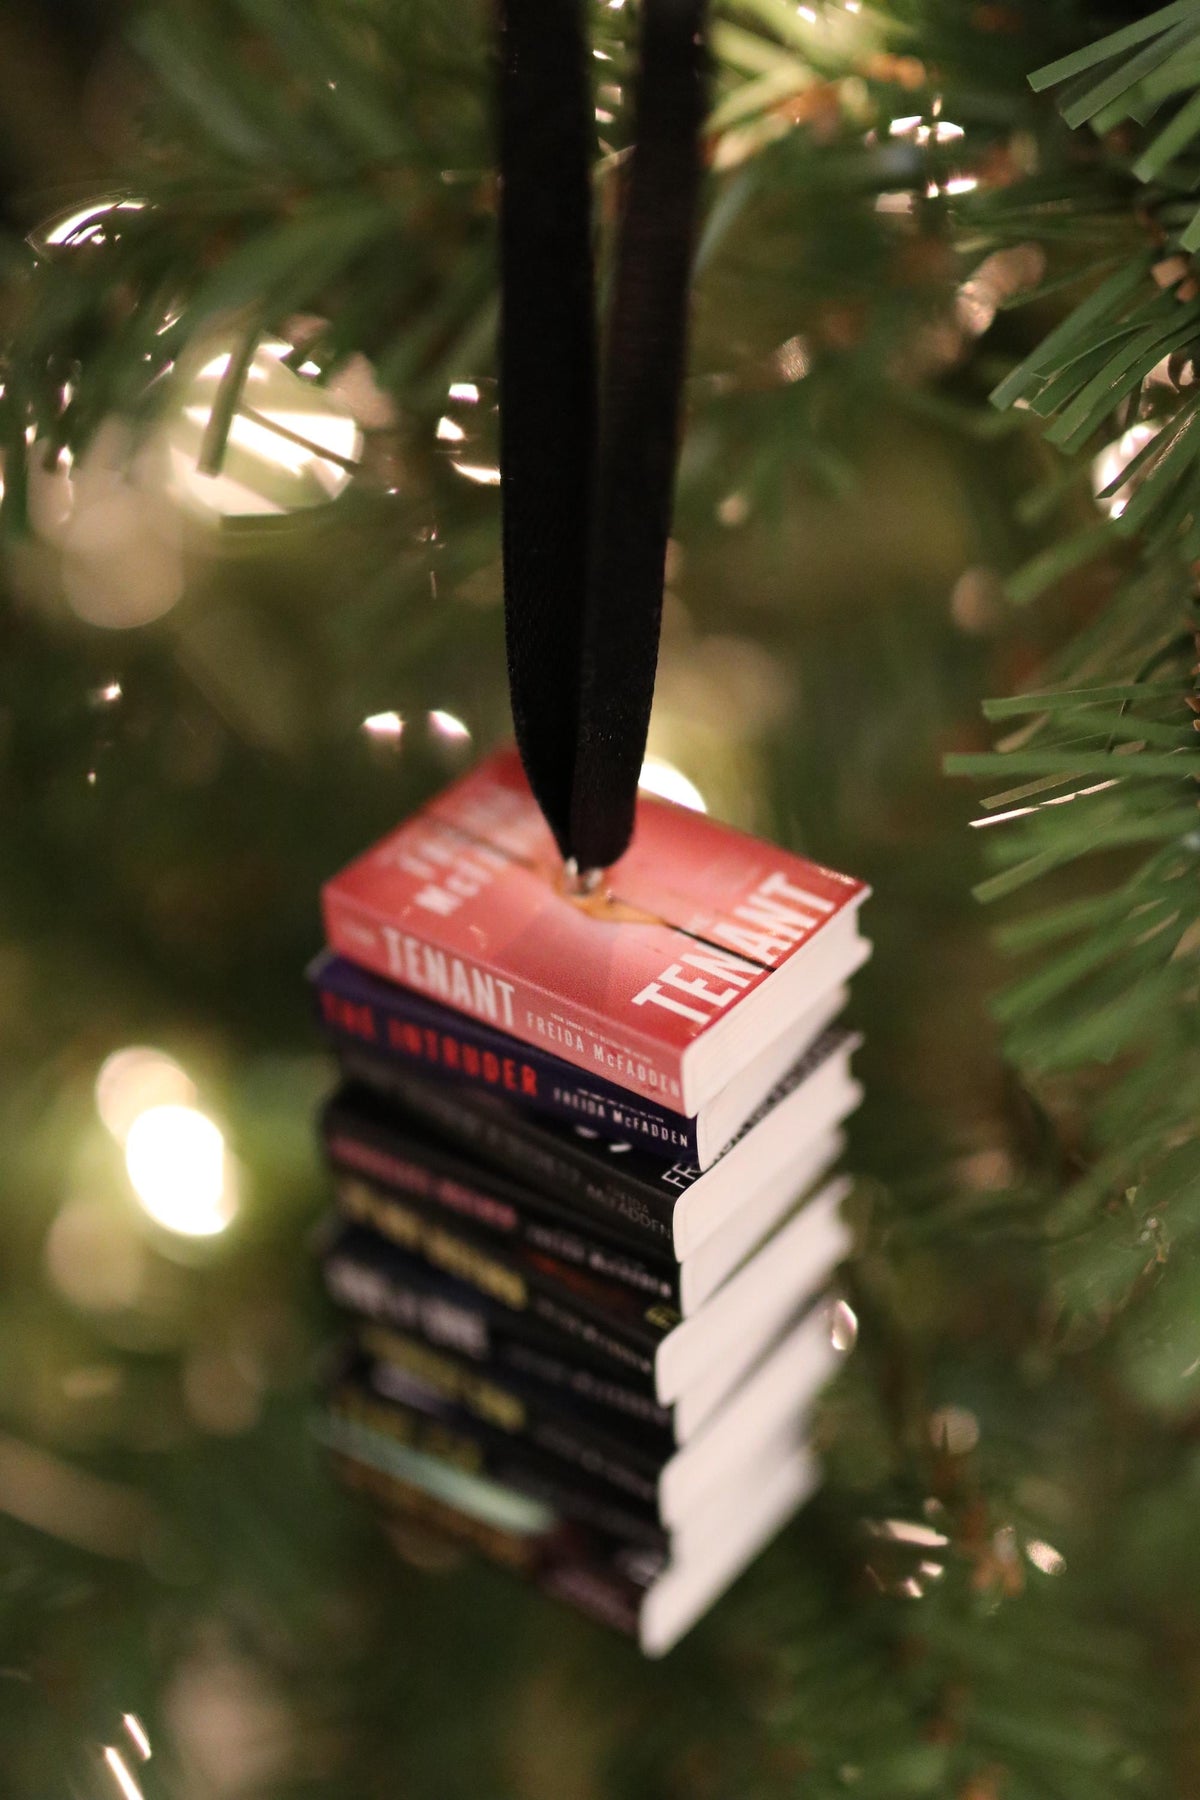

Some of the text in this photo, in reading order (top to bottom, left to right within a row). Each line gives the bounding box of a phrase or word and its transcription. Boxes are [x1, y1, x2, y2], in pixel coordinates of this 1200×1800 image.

[382, 926, 516, 1028] TENANT
[631, 873, 836, 1024] TENANT
[387, 1020, 538, 1096] INTRUDER
[525, 1010, 585, 1054] FREIDA
[593, 1042, 682, 1099] McFADDEN
[612, 1109, 689, 1149] McFADDEN
